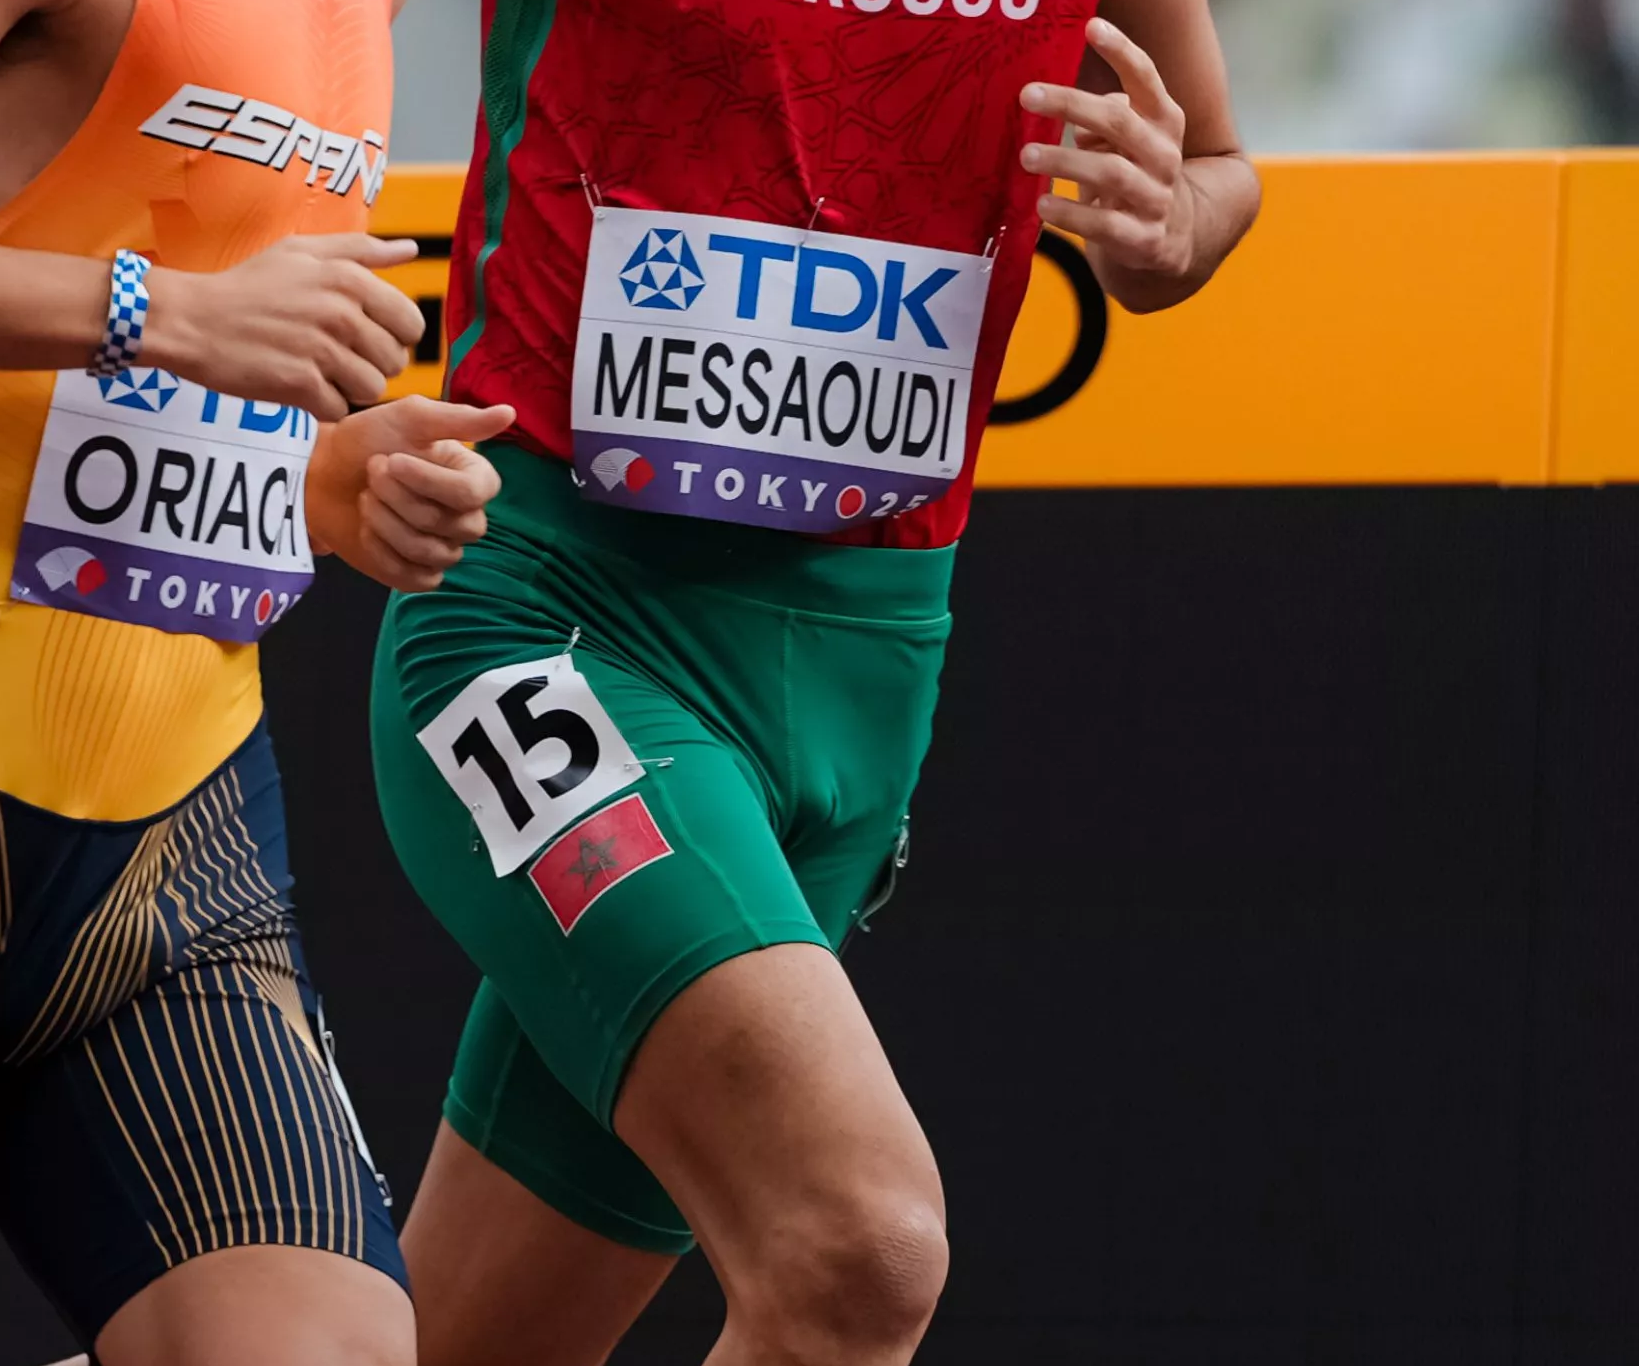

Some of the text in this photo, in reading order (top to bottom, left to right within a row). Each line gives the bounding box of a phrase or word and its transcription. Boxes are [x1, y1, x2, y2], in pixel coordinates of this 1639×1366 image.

[709, 232, 962, 351] TDK
[593, 331, 956, 463] MESSAOUDI
[451, 675, 600, 833] 15
